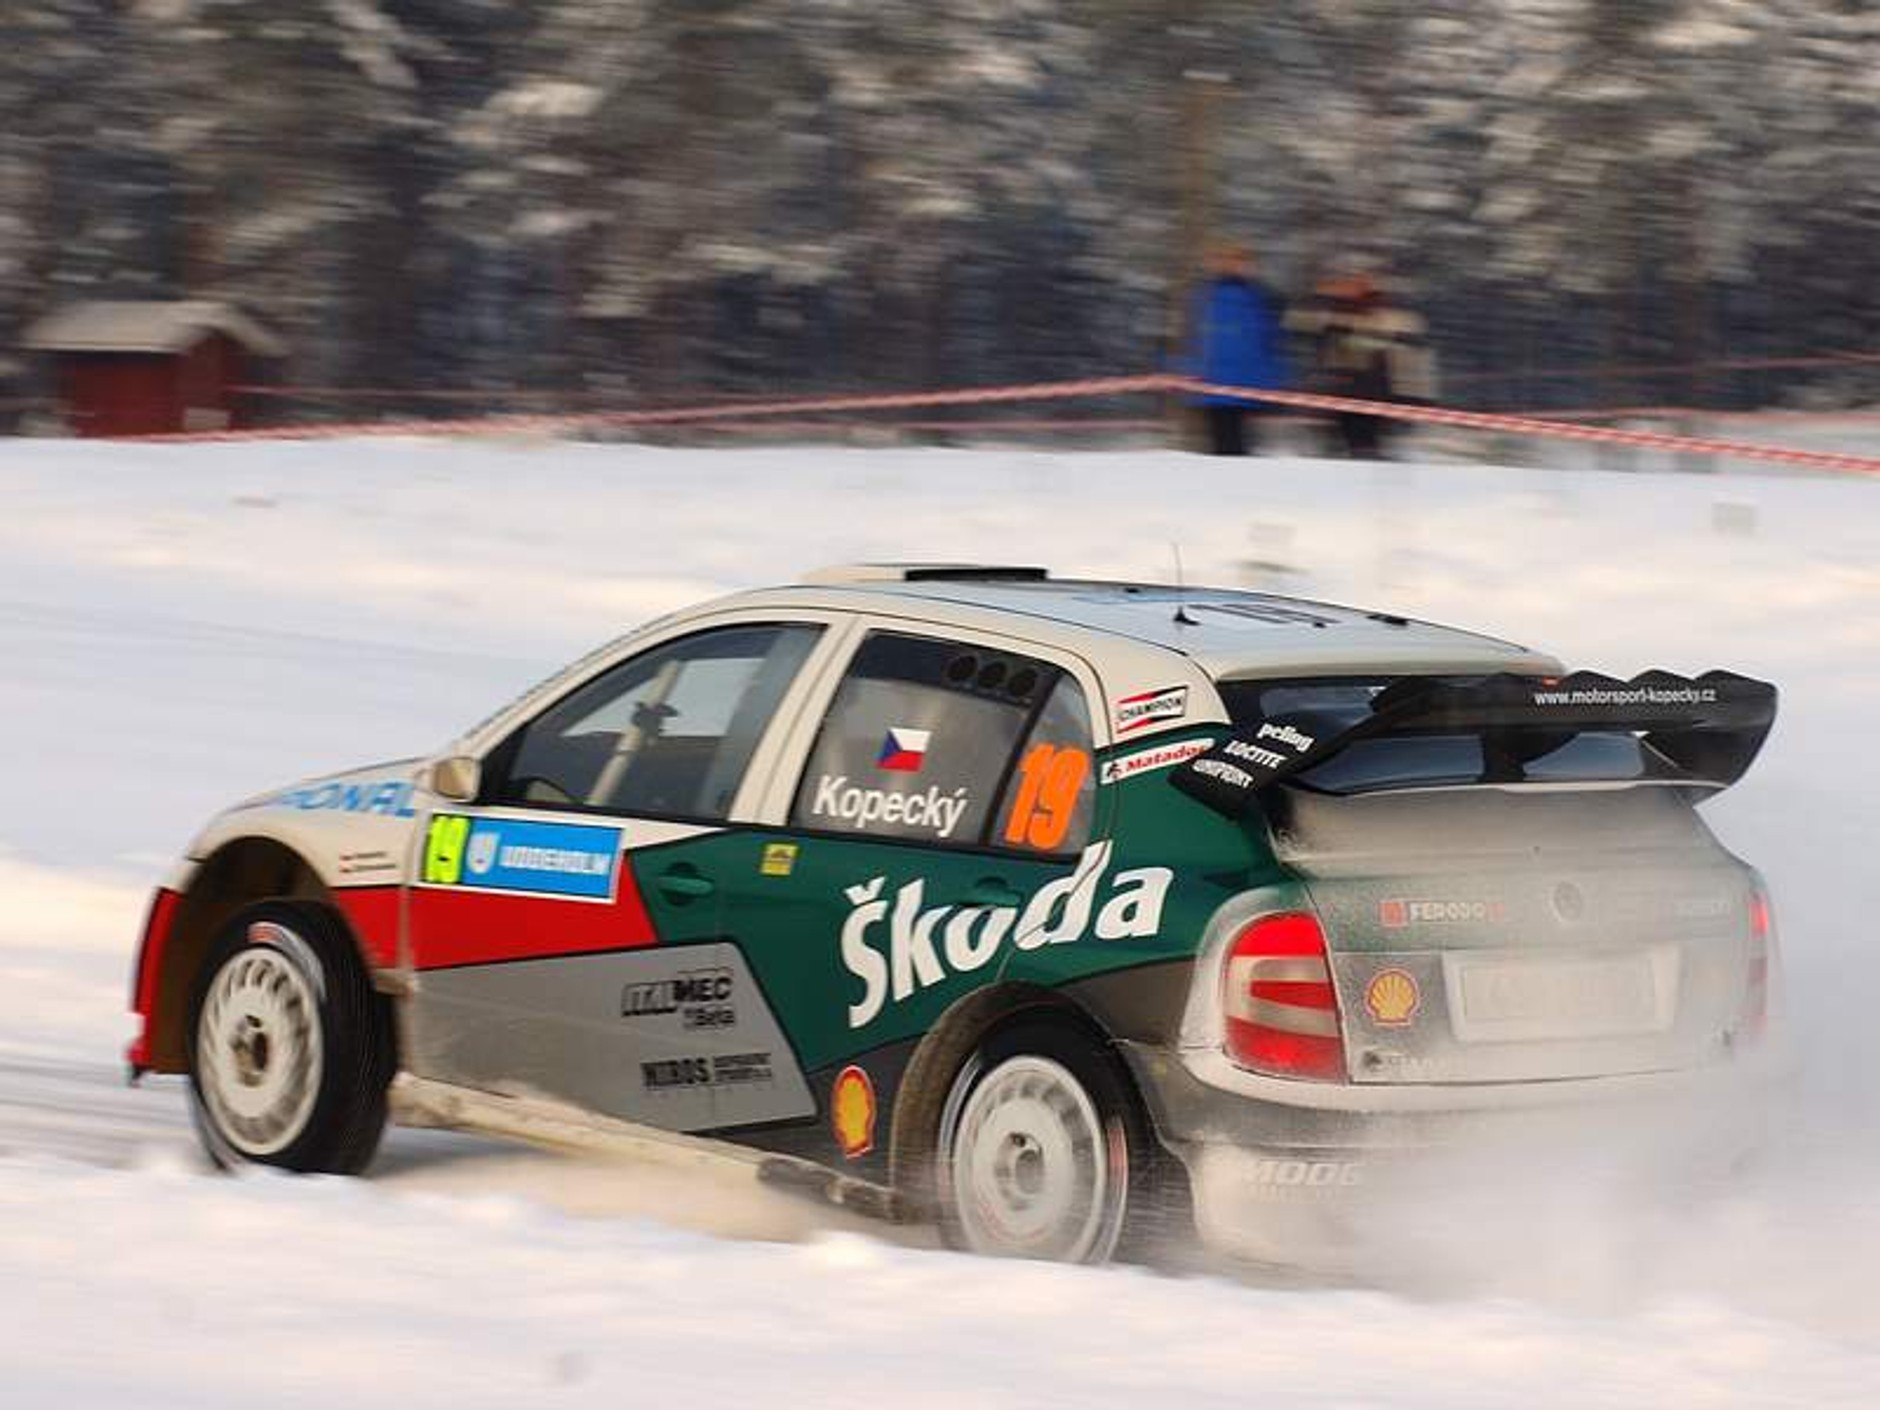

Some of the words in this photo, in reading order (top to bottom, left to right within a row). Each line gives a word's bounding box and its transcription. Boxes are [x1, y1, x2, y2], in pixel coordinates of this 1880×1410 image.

[1118, 697, 1183, 722] CHAMPION
[1126, 744, 1206, 770] Matador
[1224, 740, 1288, 769] LOCTITE
[812, 775, 966, 837] Kopecký
[1004, 744, 1091, 849] 19
[427, 815, 471, 883] 19
[1409, 901, 1488, 921] FERODO
[840, 841, 1173, 1028] Škoda
